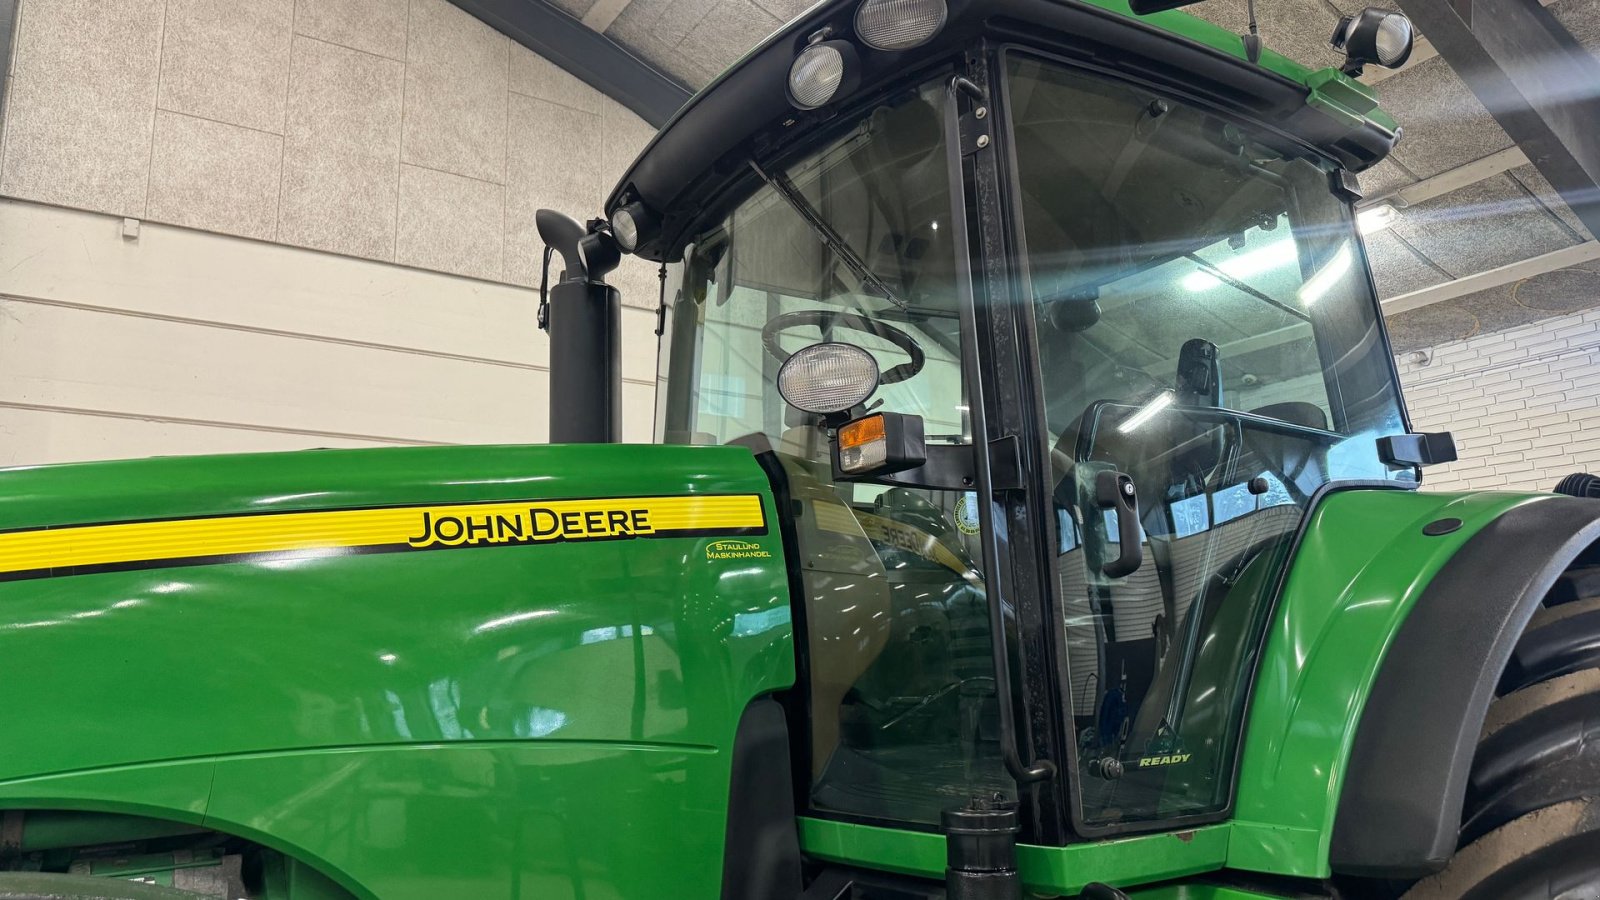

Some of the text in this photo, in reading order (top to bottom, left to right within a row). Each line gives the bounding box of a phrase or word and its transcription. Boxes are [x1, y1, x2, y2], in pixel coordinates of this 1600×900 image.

[408, 508, 652, 543] JOHN DEERE
[715, 543, 760, 551] STAULUND
[706, 551, 772, 559] MASKINHANDEL
[1139, 753, 1192, 767] READY
